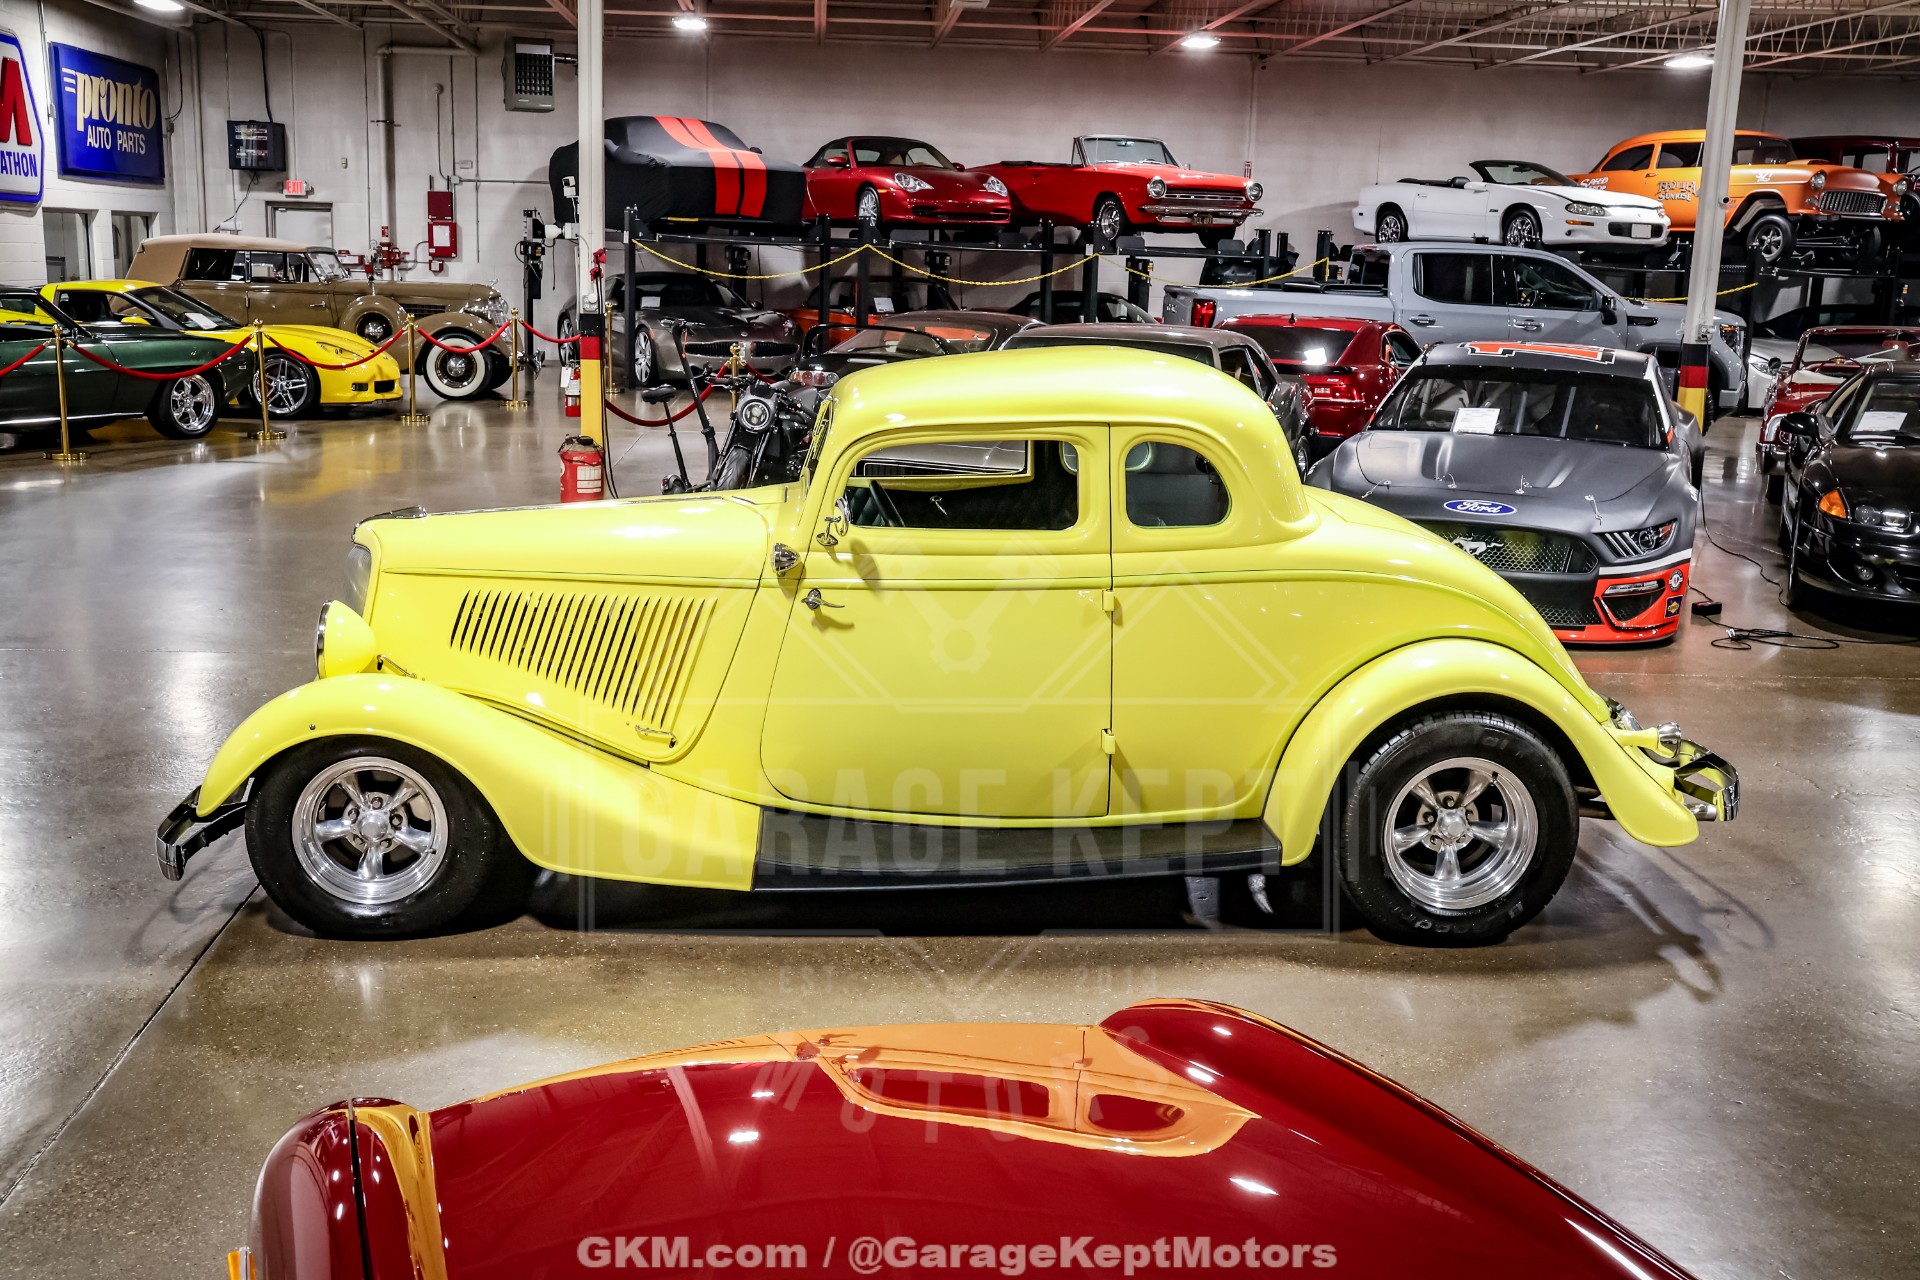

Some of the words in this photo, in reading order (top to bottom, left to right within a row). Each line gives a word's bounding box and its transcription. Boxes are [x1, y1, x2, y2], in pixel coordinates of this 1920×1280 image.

[75, 71, 157, 132] pronto
[87, 125, 112, 150] AUTO
[117, 130, 146, 155] PARTS
[285, 180, 303, 193] EXIT
[1456, 501, 1502, 513] Ford
